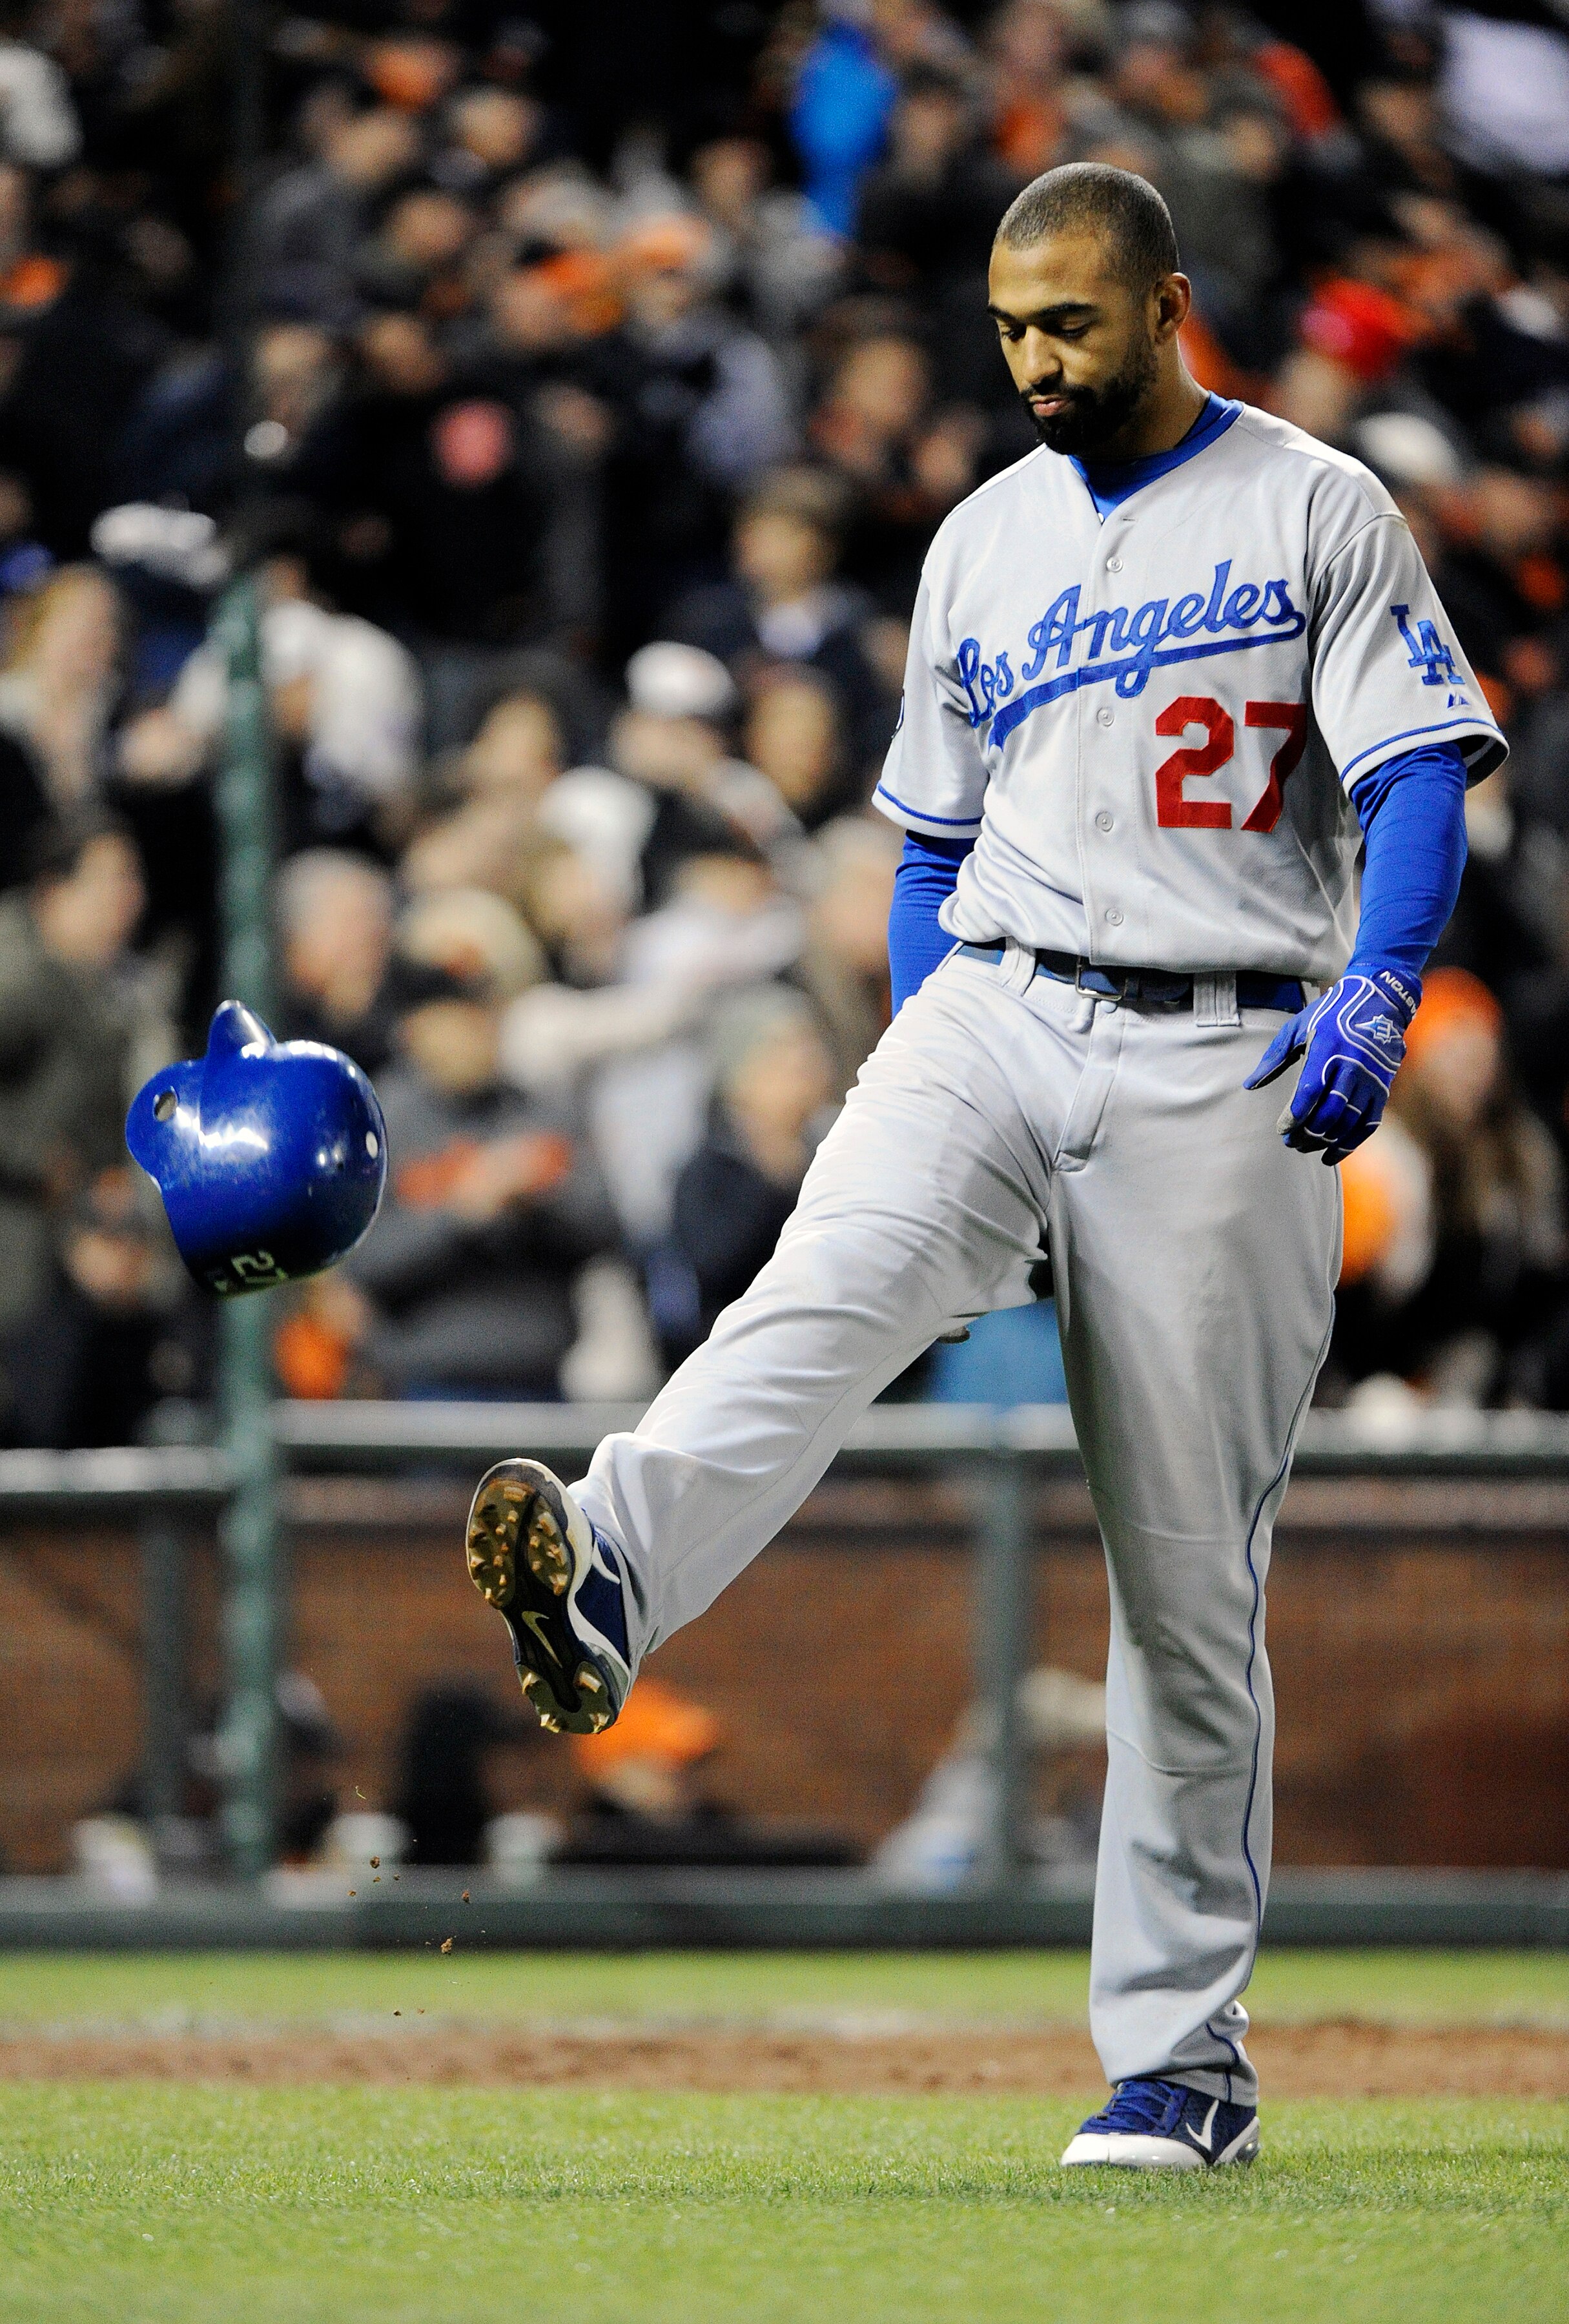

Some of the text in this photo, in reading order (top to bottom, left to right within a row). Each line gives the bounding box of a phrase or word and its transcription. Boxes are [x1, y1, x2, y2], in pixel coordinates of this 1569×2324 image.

[958, 559, 1306, 728] Los Angeles
[1390, 604, 1466, 686] LA
[1156, 696, 1307, 833] 27
[1379, 970, 1417, 1016] ASTON
[231, 1248, 287, 1285] 27
